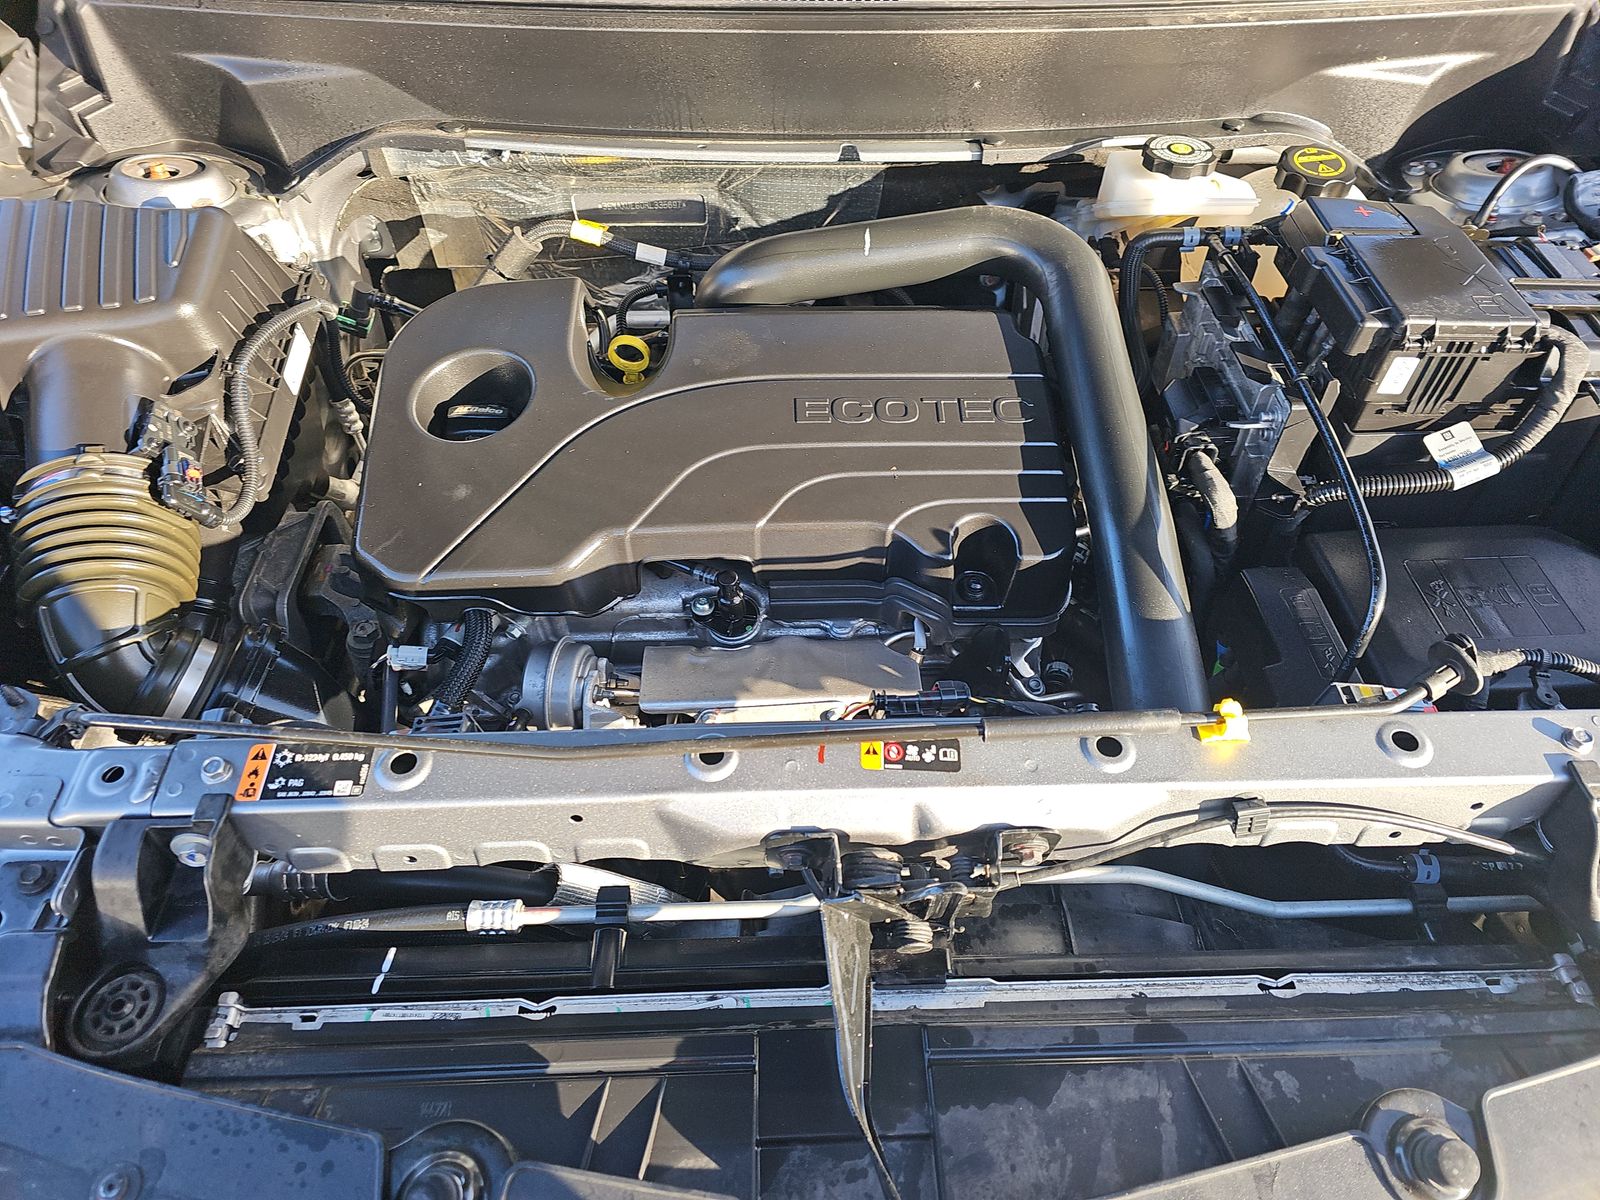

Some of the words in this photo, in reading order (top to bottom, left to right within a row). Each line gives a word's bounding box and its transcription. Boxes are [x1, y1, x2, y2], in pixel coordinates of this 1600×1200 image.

[450, 405, 504, 414] ACDelco
[793, 397, 1035, 424] ECOTEC
[287, 779, 305, 787] PAG
